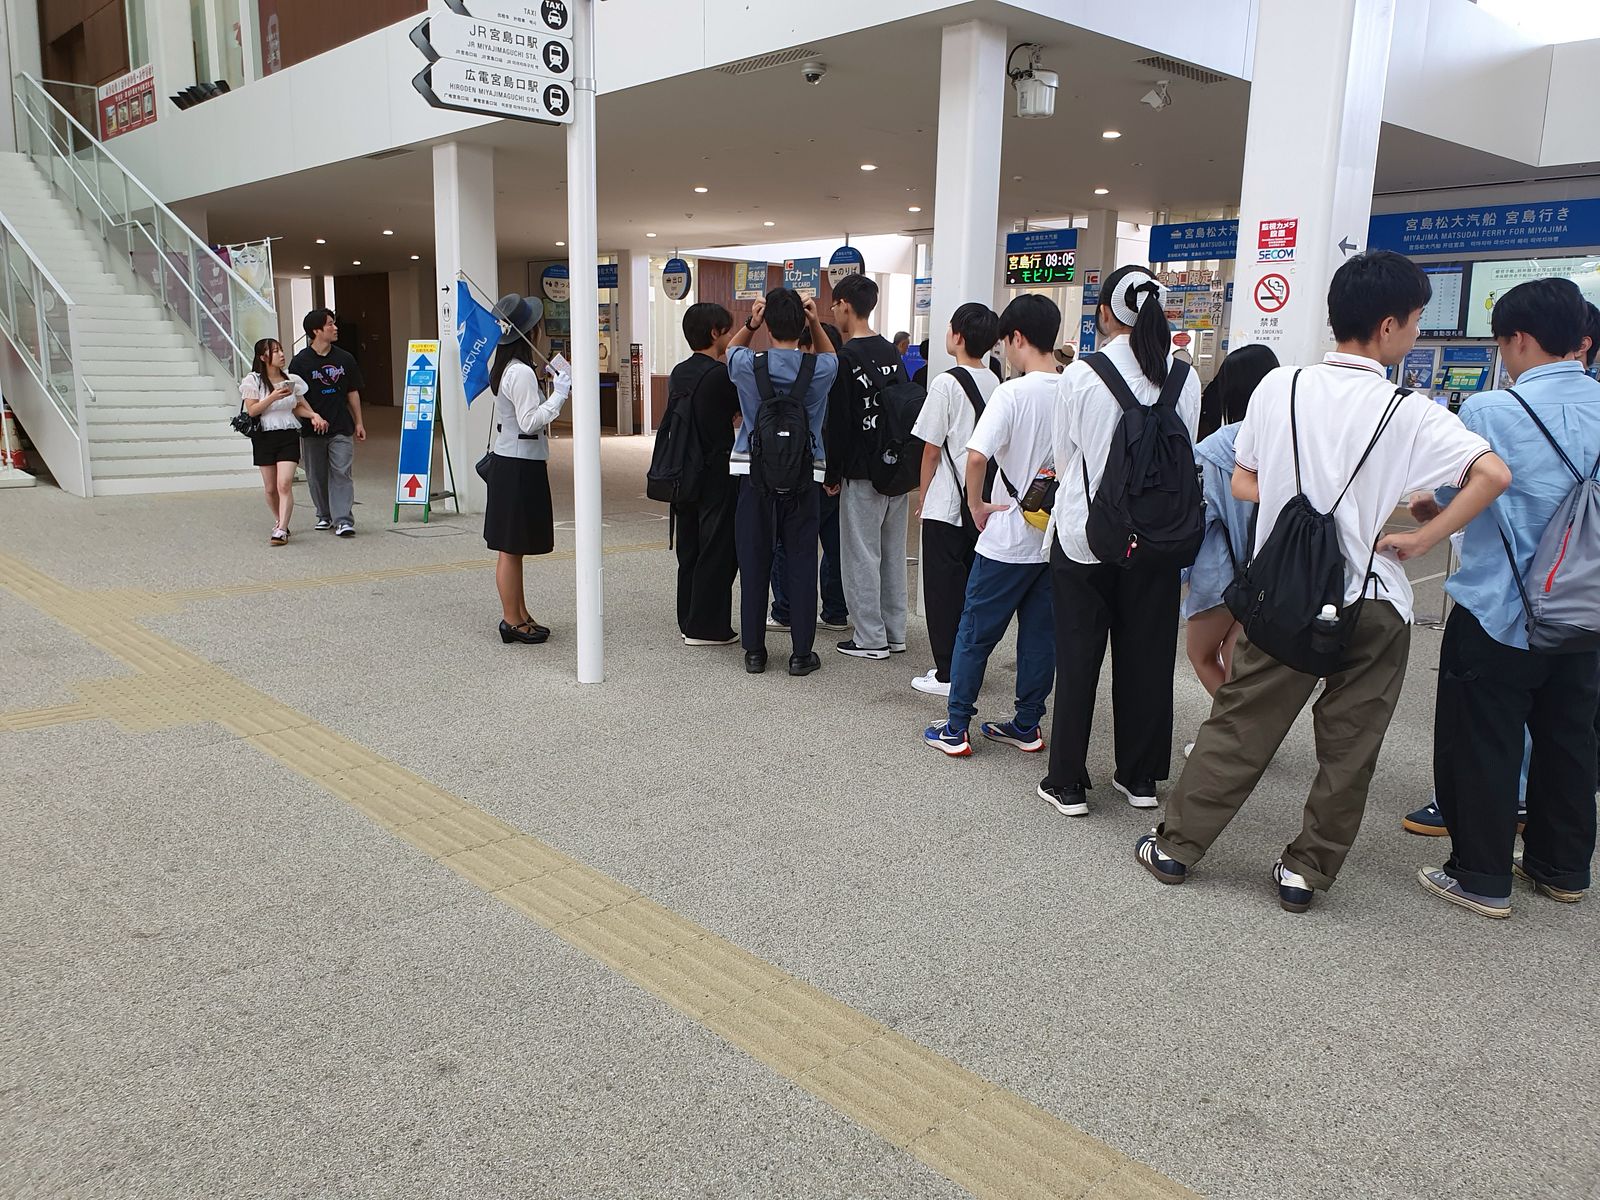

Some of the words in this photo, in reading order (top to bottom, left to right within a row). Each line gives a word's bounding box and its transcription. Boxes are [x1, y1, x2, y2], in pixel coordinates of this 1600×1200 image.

[524, 8, 537, 17] TAXI
[545, 1, 564, 12] TAXI
[469, 24, 538, 50] JR宮島口駅
[477, 42, 524, 58] MIYAJIMAGUCHI
[525, 52, 539, 61] STA.
[465, 68, 539, 93] 広電宮島口駅
[449, 82, 477, 94] HIRODEN
[478, 86, 526, 102] MIYAJIMAGUCHI
[527, 96, 539, 105] STA.
[1405, 212, 1497, 232] 宮島松大汽船
[1505, 207, 1570, 225] 宮島行き
[1403, 233, 1439, 242] MIYAJIMA
[1440, 231, 1480, 241] MATSUDAI
[1482, 229, 1506, 237] FERRY
[1509, 227, 1524, 235] FOR
[1527, 225, 1568, 234] MIYAJIMA
[1008, 254, 1042, 270] 宮島行
[1045, 252, 1075, 267] 09:05
[1258, 249, 1294, 260] SECOM
[785, 268, 818, 282] ICカード
[1211, 279, 1222, 325] 団体受付
[1260, 317, 1279, 327] 禁煙
